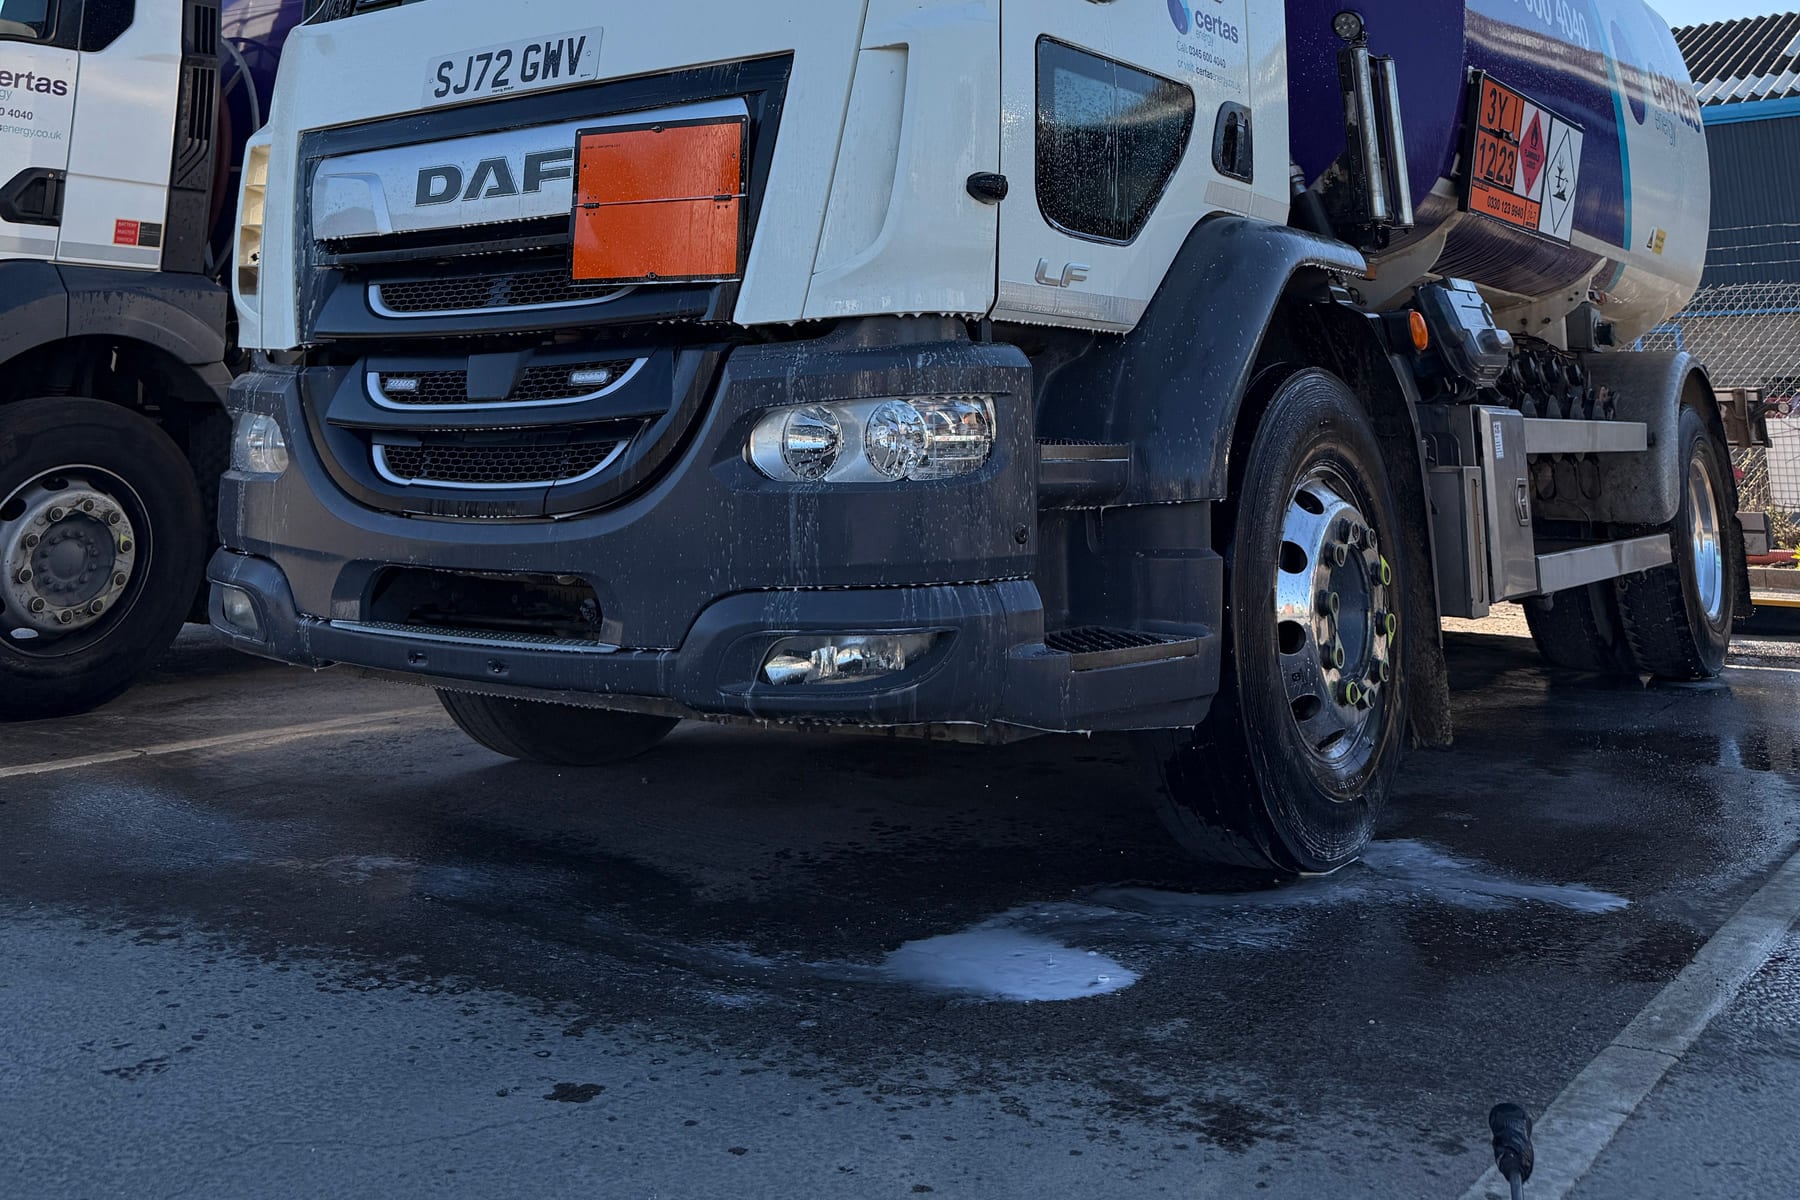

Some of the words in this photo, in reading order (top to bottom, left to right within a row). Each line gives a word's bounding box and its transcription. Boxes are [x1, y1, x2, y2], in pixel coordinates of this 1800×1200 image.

[1195, 10, 1239, 44] certas
[434, 48, 513, 98] SJ72
[520, 35, 586, 83] GWV
[1188, 45, 1202, 59] 0345
[1202, 51, 1213, 64] 600
[8, 108, 33, 120] 4040
[1487, 87, 1508, 128] 3Y
[414, 147, 574, 207] DAF
[1479, 138, 1515, 188] 1223
[1487, 195, 1501, 210] 0330
[1501, 200, 1511, 215] 123
[1034, 257, 1091, 288] LF
